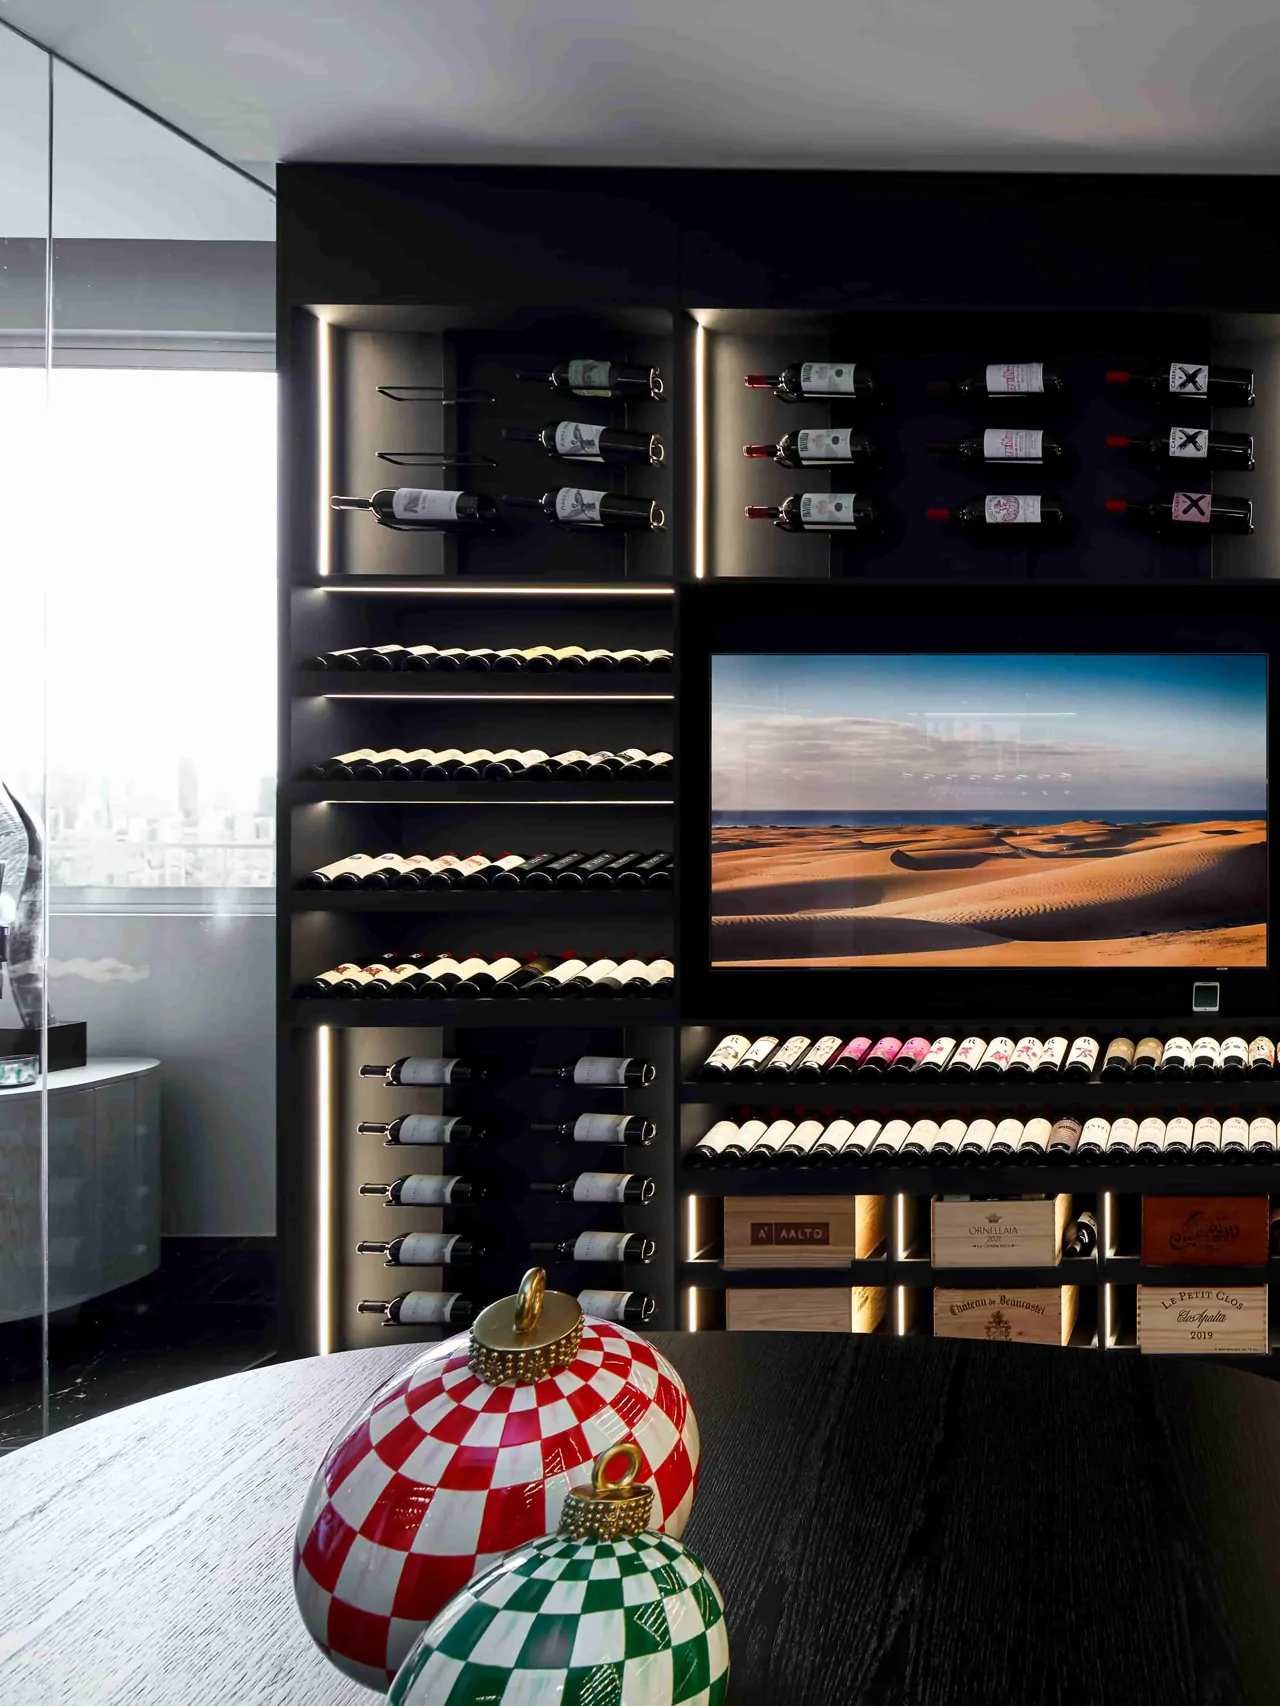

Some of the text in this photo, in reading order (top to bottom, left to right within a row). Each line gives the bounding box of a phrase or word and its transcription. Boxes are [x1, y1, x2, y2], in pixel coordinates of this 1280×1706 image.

[780, 1228, 823, 1239] AALTO
[969, 1226, 1018, 1235] ORNELLAIA
[988, 1298, 996, 1306] de
[998, 1294, 1046, 1316] Beaucastel
[1161, 1290, 1244, 1310] LE PETIT CLOS
[1190, 1331, 1213, 1340] 2019
